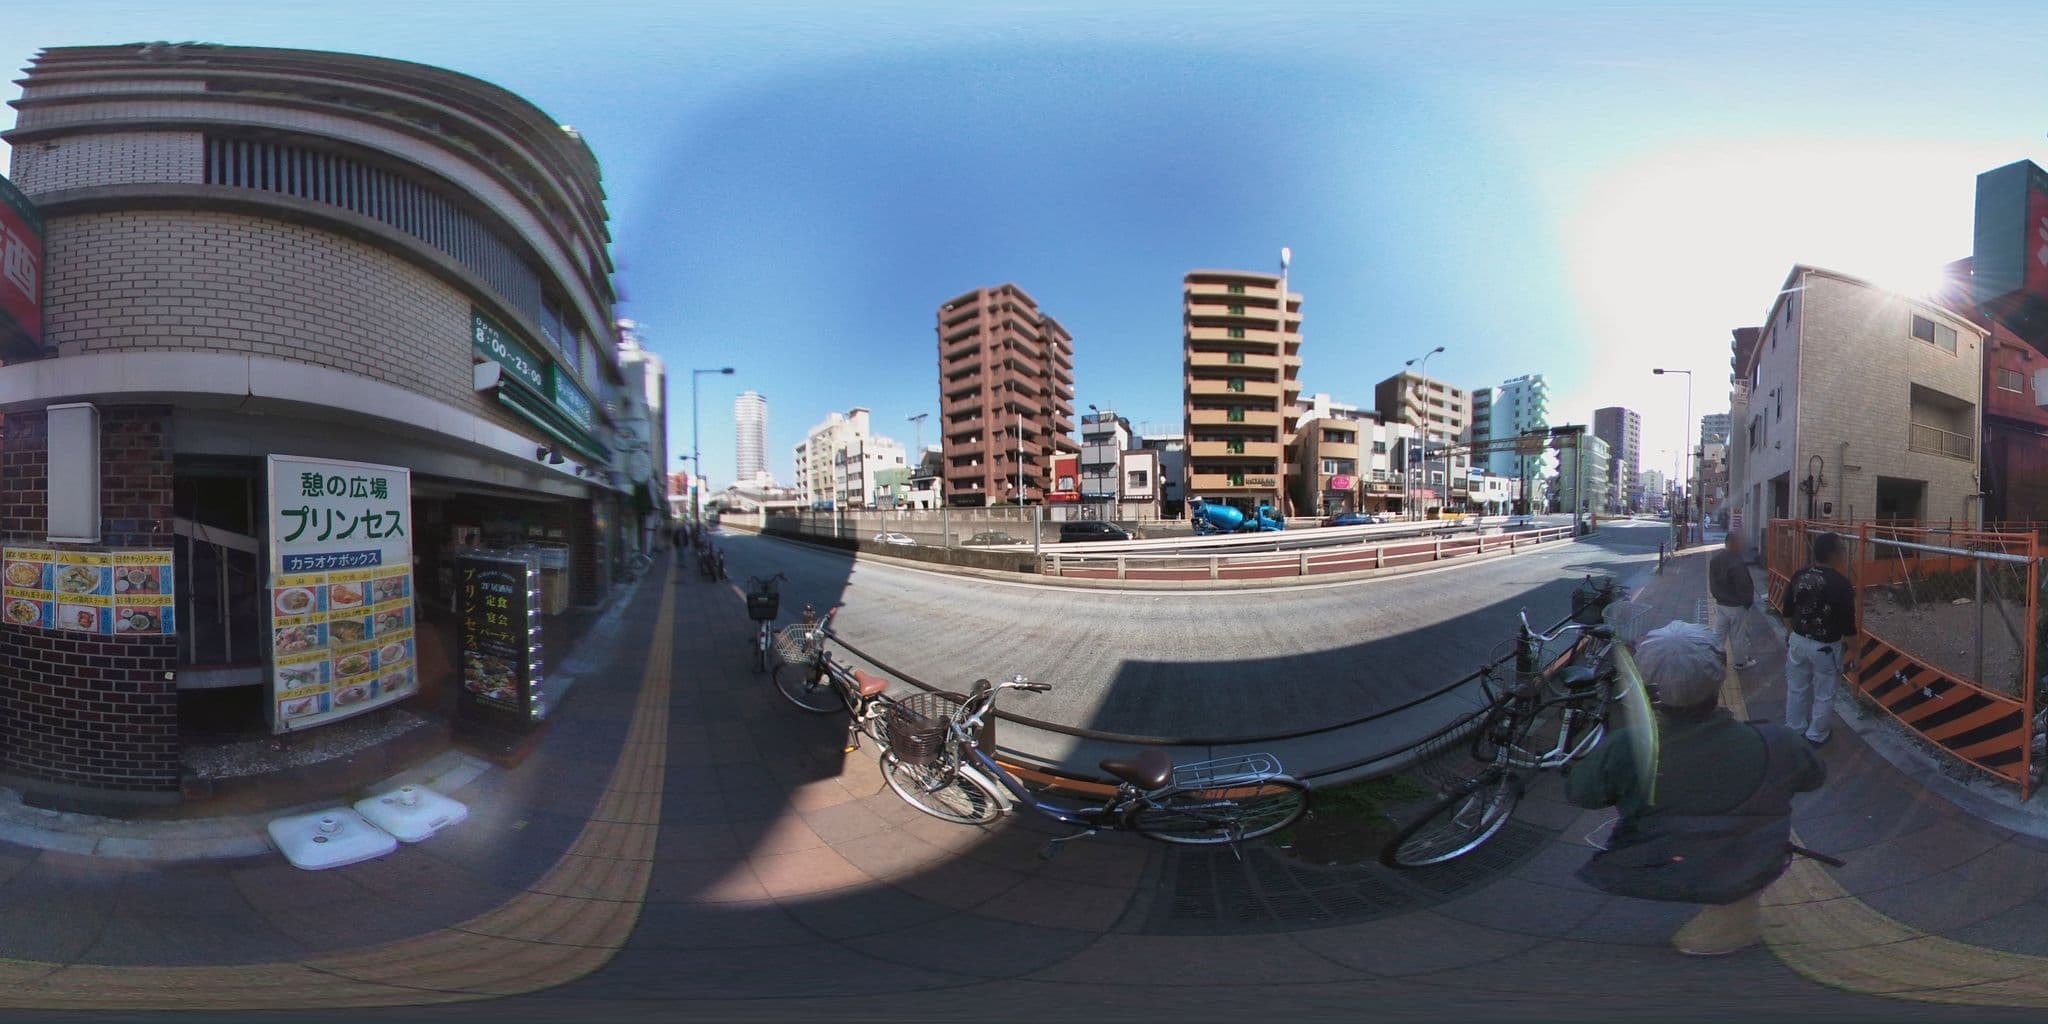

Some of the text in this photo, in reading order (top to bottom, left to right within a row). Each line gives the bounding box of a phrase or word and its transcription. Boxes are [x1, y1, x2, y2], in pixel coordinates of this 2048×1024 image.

[301, 472, 388, 500] 憩の広場
[281, 505, 404, 541] プリンセス
[290, 552, 378, 570] カラオケボックス
[464, 568, 478, 648] プリンセス
